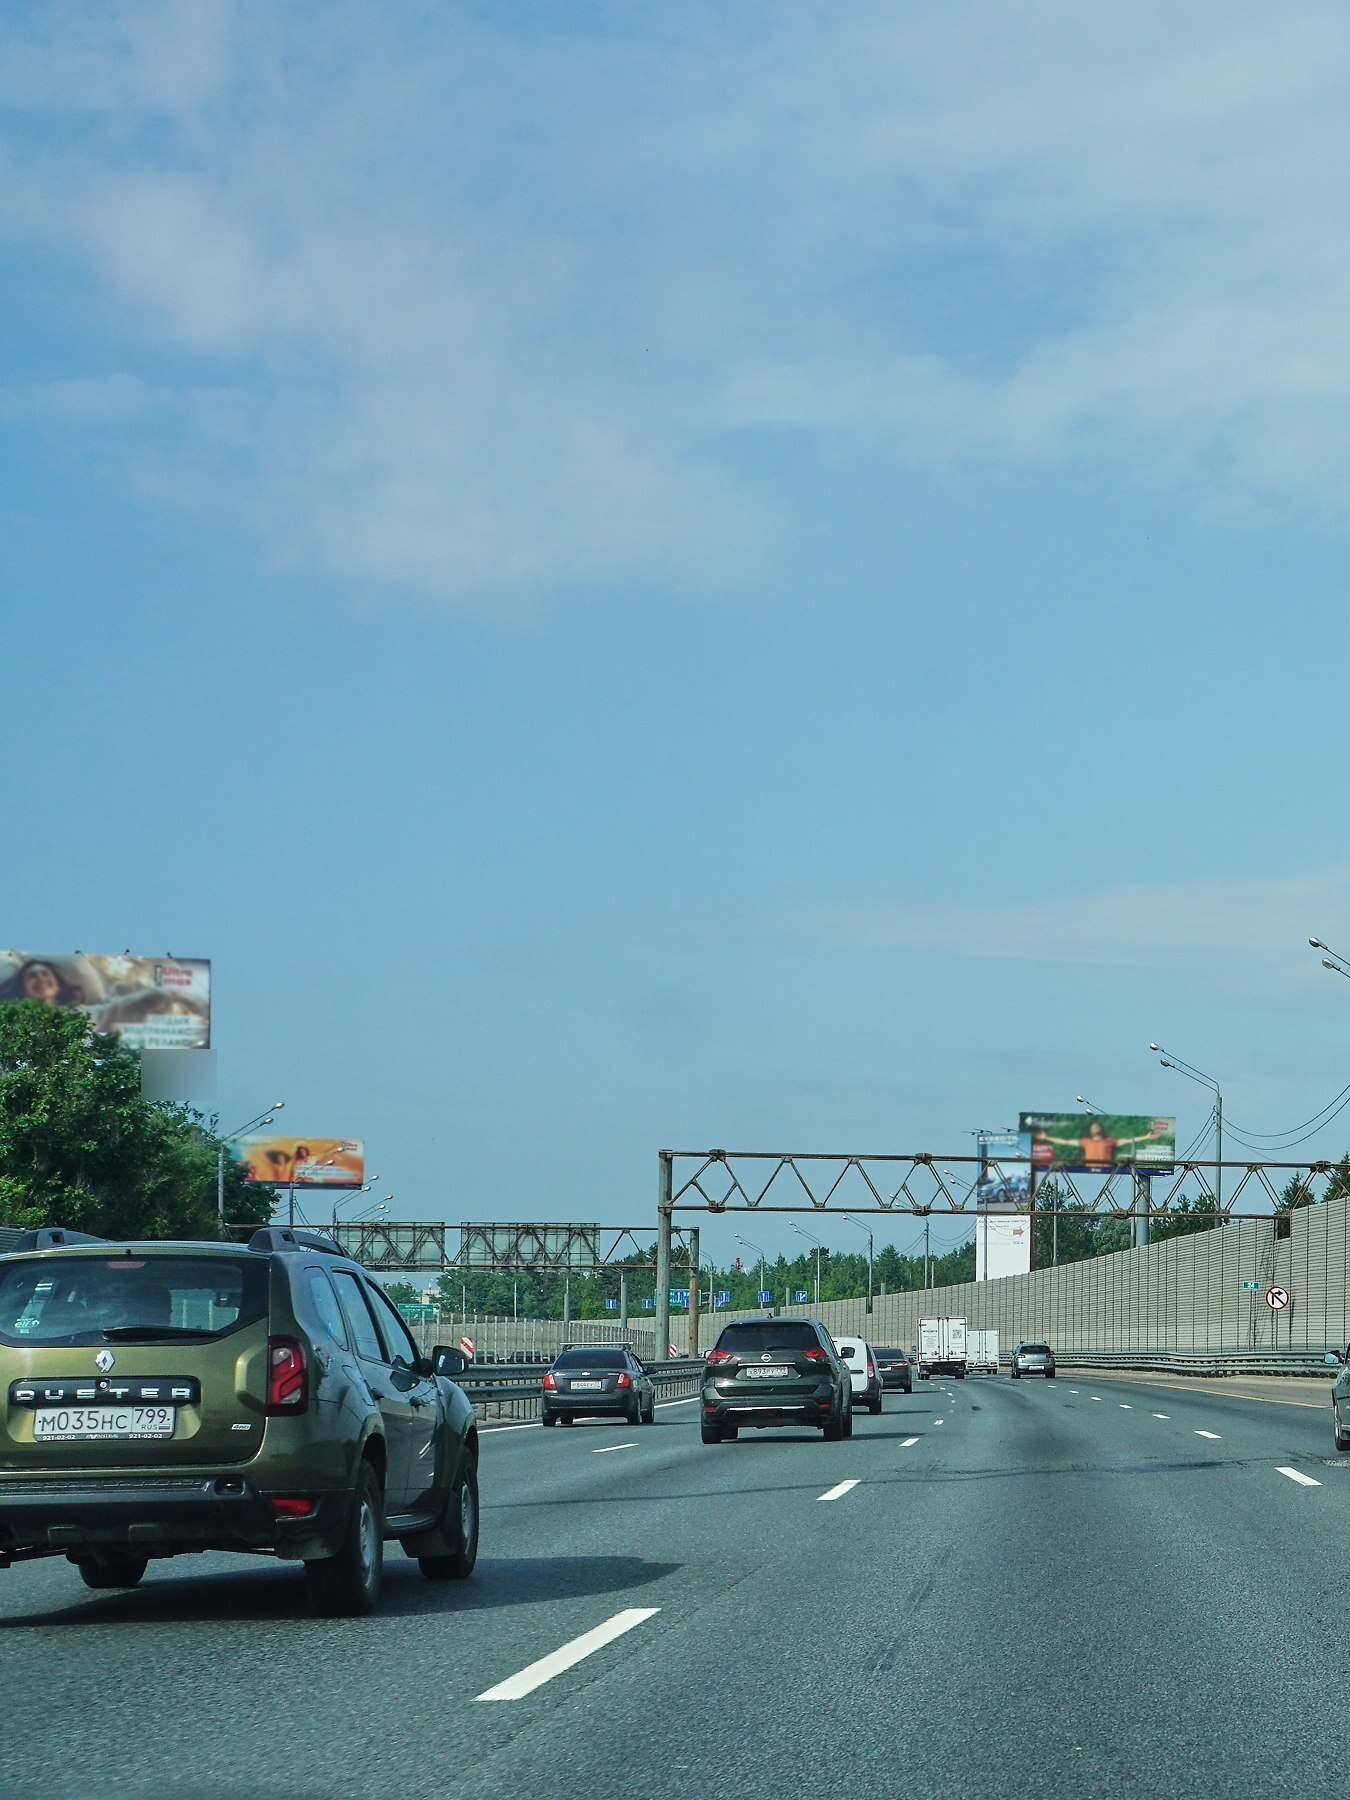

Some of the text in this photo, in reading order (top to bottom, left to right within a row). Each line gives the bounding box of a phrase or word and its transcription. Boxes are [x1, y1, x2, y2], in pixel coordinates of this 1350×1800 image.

[16, 1387, 191, 1401] DUSTER
[41, 1408, 167, 1431] М035НС 799
